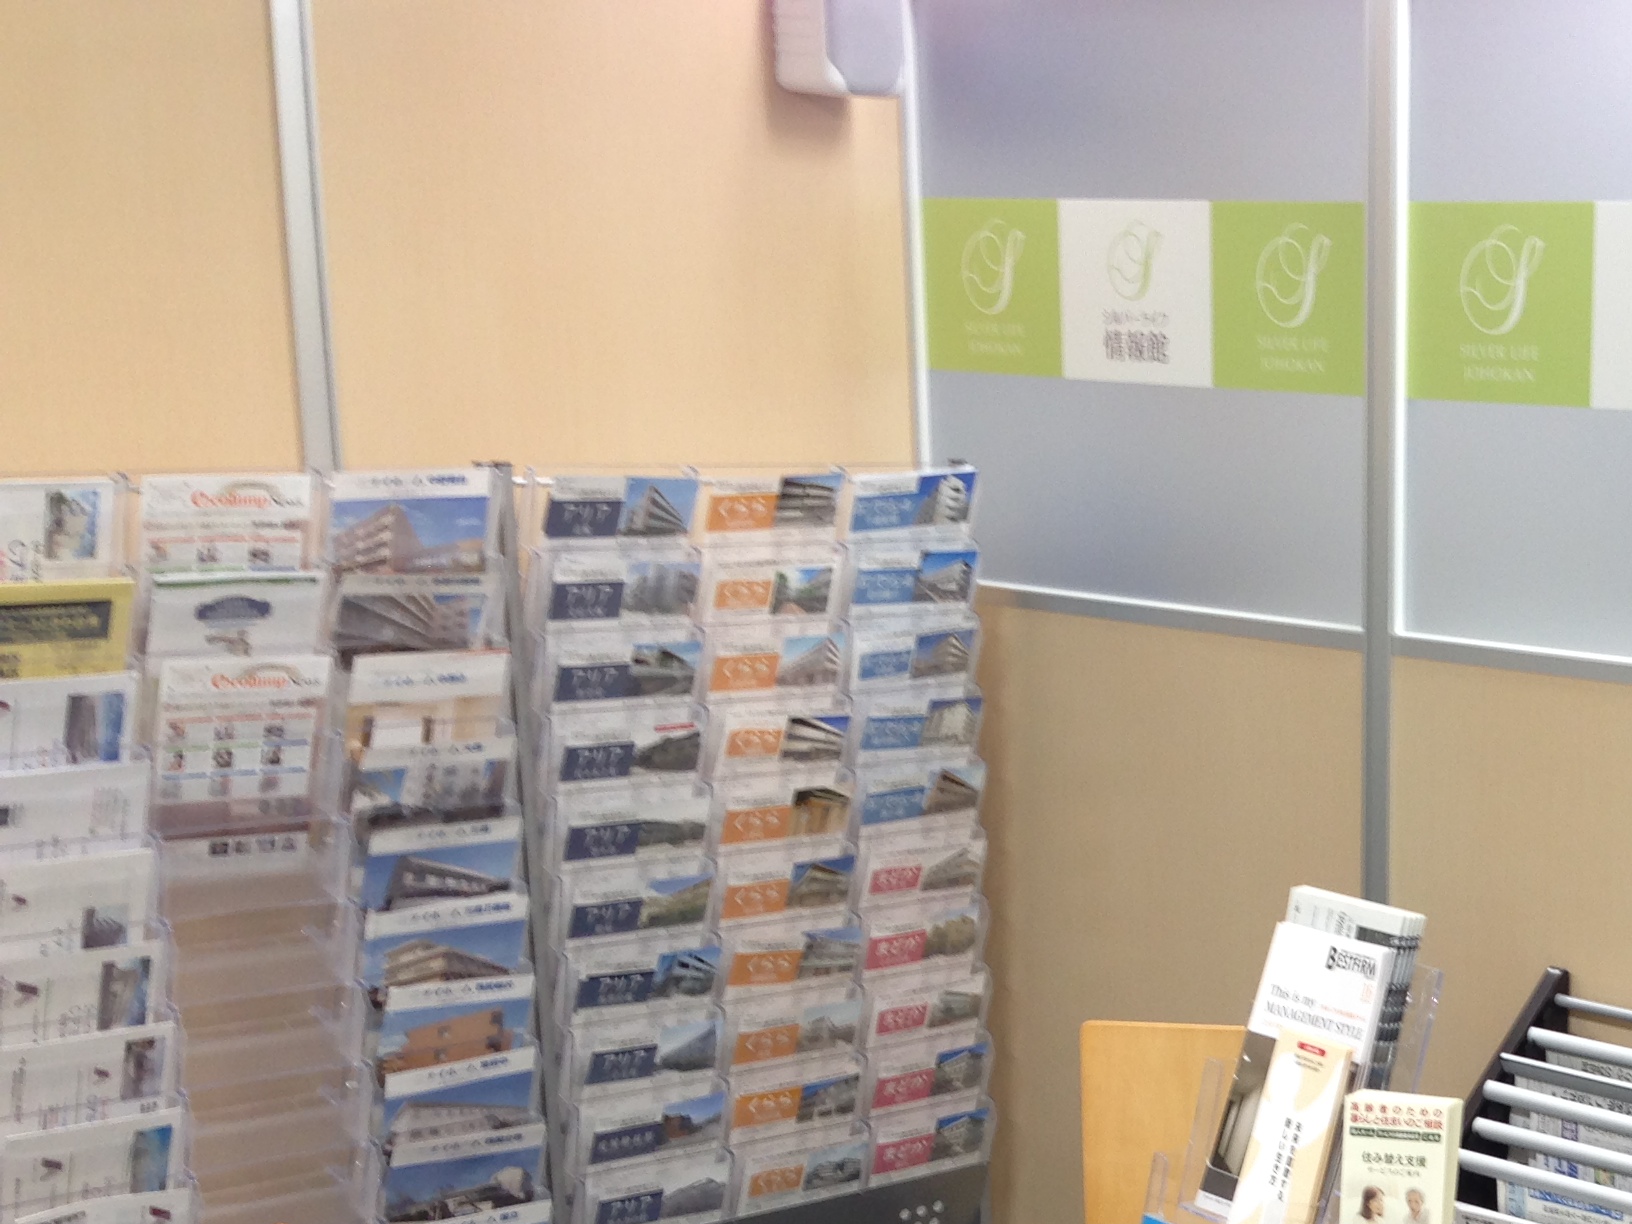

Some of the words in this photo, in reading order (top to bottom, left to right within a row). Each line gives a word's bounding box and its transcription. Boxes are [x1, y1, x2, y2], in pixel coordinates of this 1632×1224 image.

[1264, 1000, 1335, 1033] MANAGEMENT
[1334, 1021, 1365, 1041] STYLE
[1361, 1150, 1427, 1168] 住み替え支援
